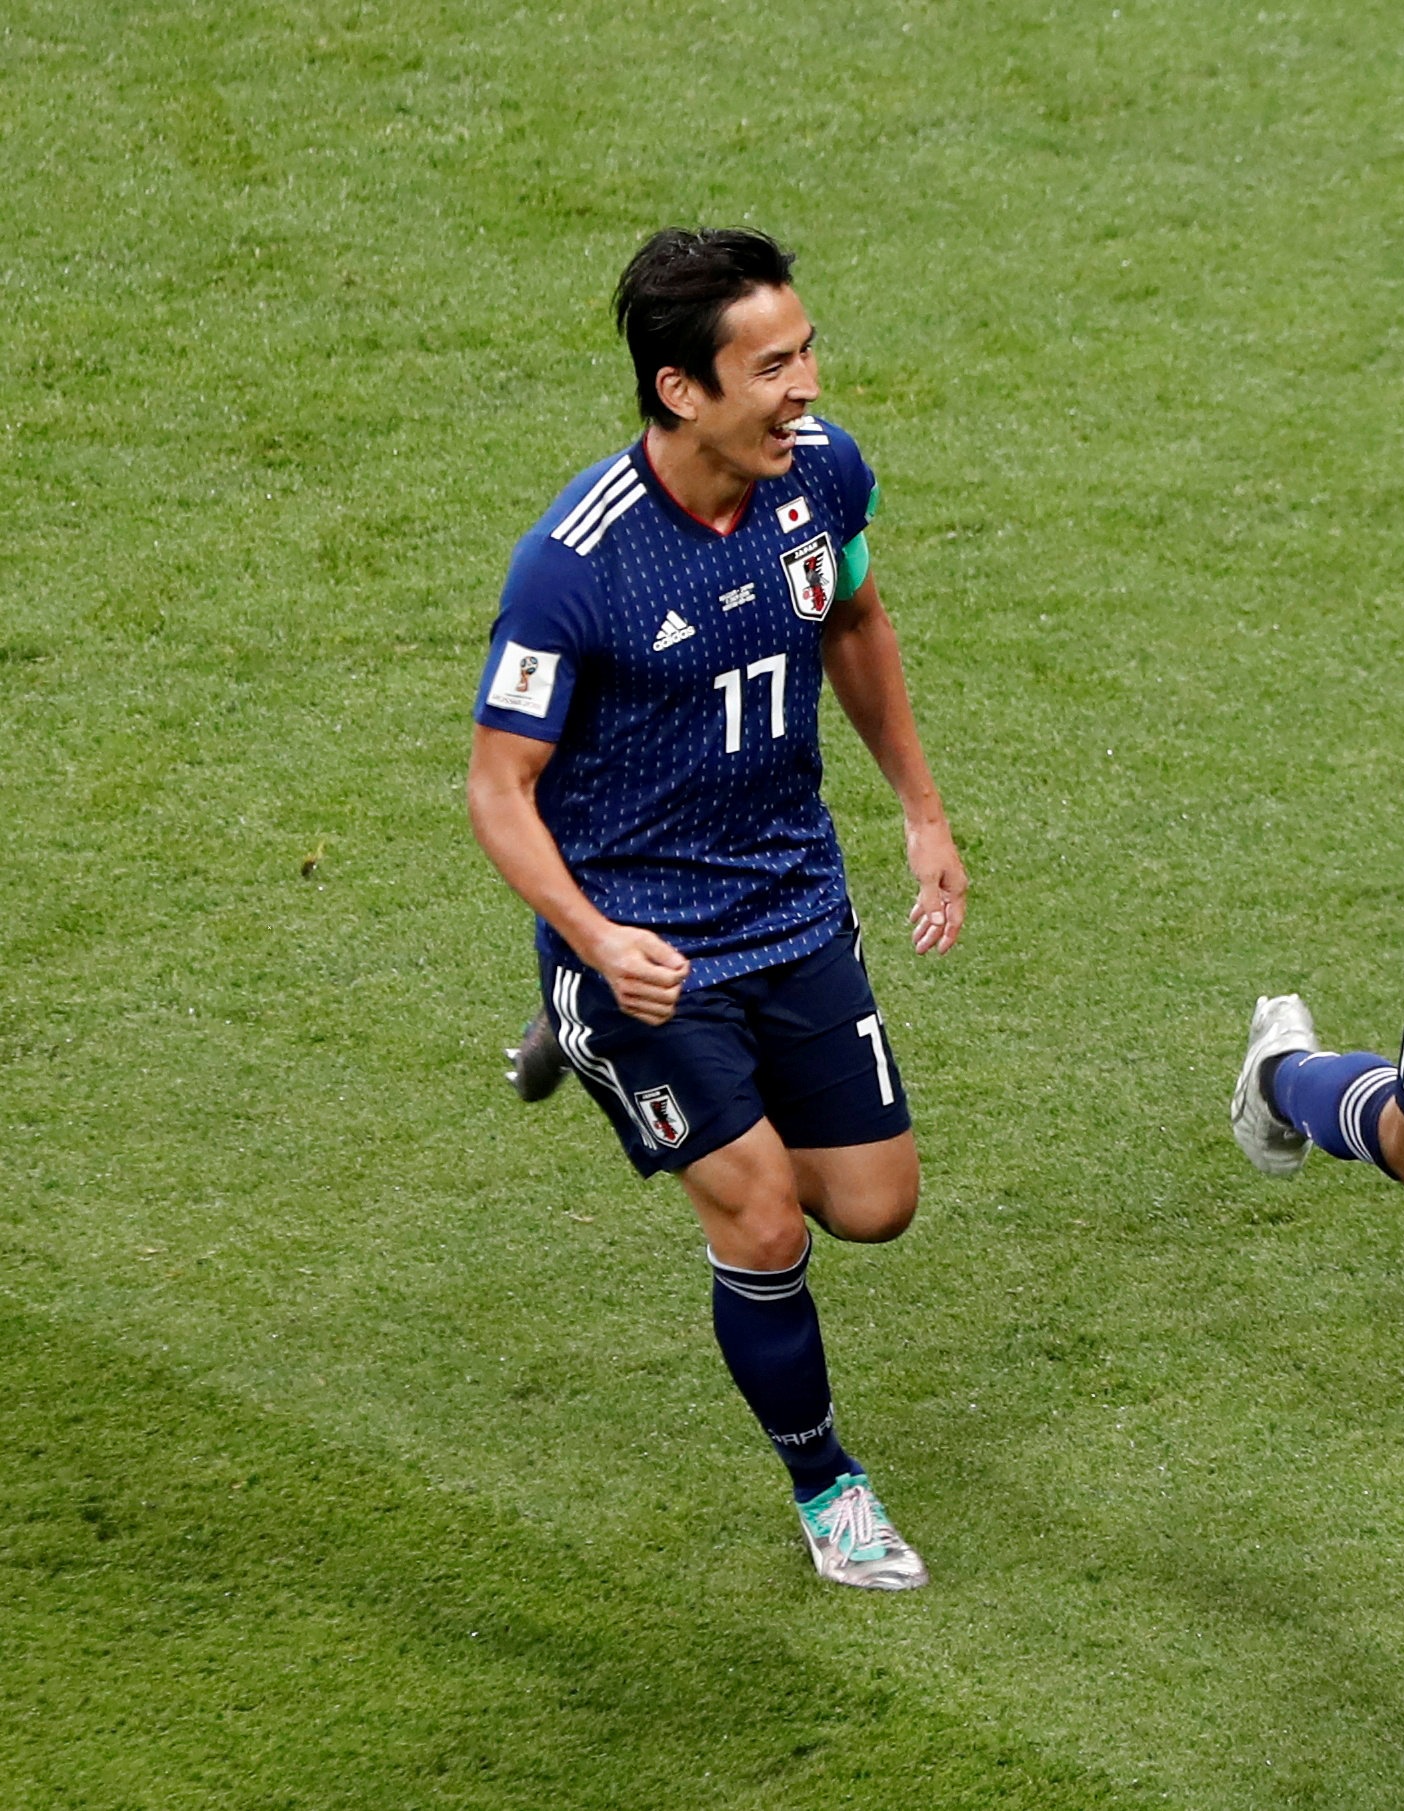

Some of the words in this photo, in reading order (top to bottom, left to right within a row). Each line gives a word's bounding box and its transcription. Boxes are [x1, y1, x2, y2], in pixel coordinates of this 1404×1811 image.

[652, 625, 696, 651] adidas
[713, 652, 786, 754] 17
[855, 1008, 895, 1106] 1
